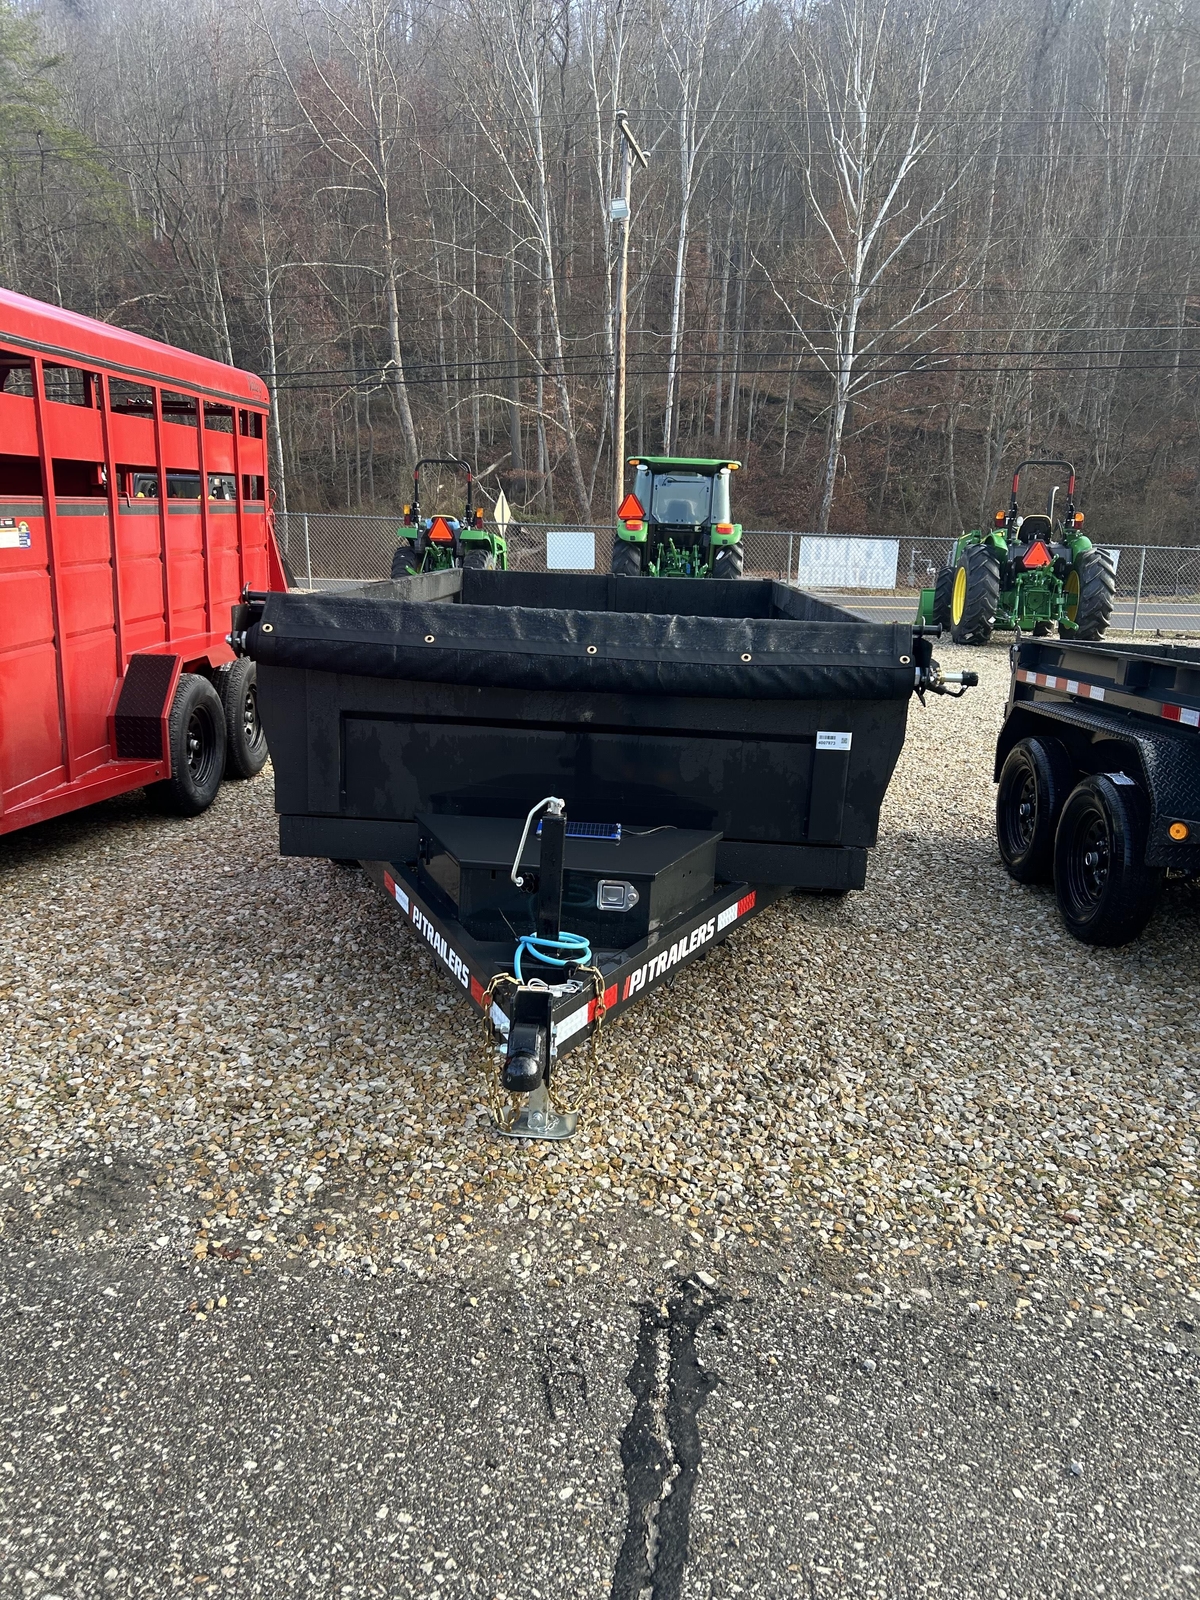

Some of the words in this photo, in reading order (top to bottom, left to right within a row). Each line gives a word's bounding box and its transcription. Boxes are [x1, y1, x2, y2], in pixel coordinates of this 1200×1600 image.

[412, 905, 423, 931] PJ
[422, 915, 470, 989] TRAILERS
[628, 963, 648, 997] PJ
[648, 917, 716, 983] TRAILERS
